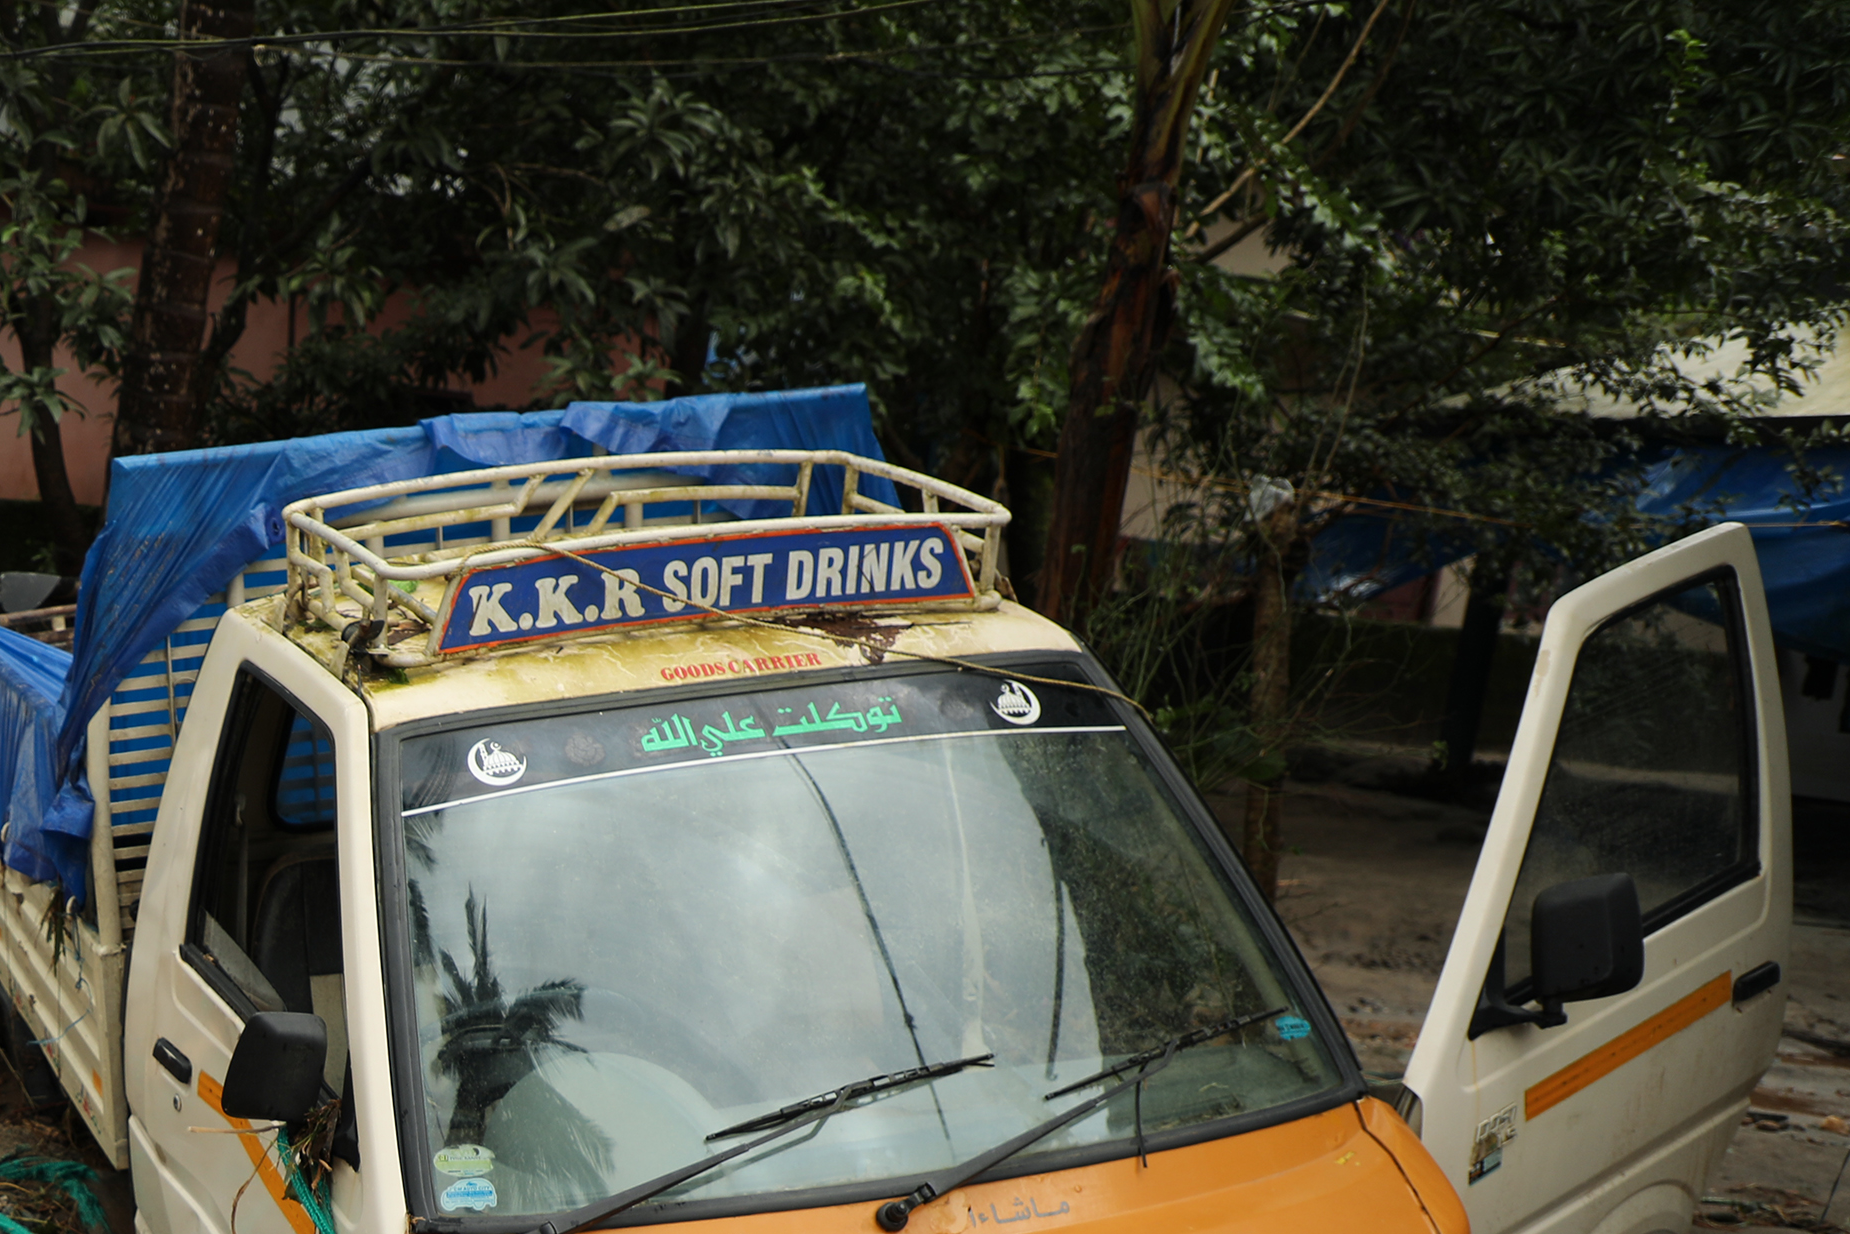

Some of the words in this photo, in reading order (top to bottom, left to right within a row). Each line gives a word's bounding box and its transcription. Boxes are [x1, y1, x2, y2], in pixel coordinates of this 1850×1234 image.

[468, 568, 645, 637] K.K.R
[662, 552, 773, 613] SOFT
[785, 537, 945, 601] DRINKS
[660, 662, 726, 681] GOODS
[728, 652, 822, 674] CARRIER
